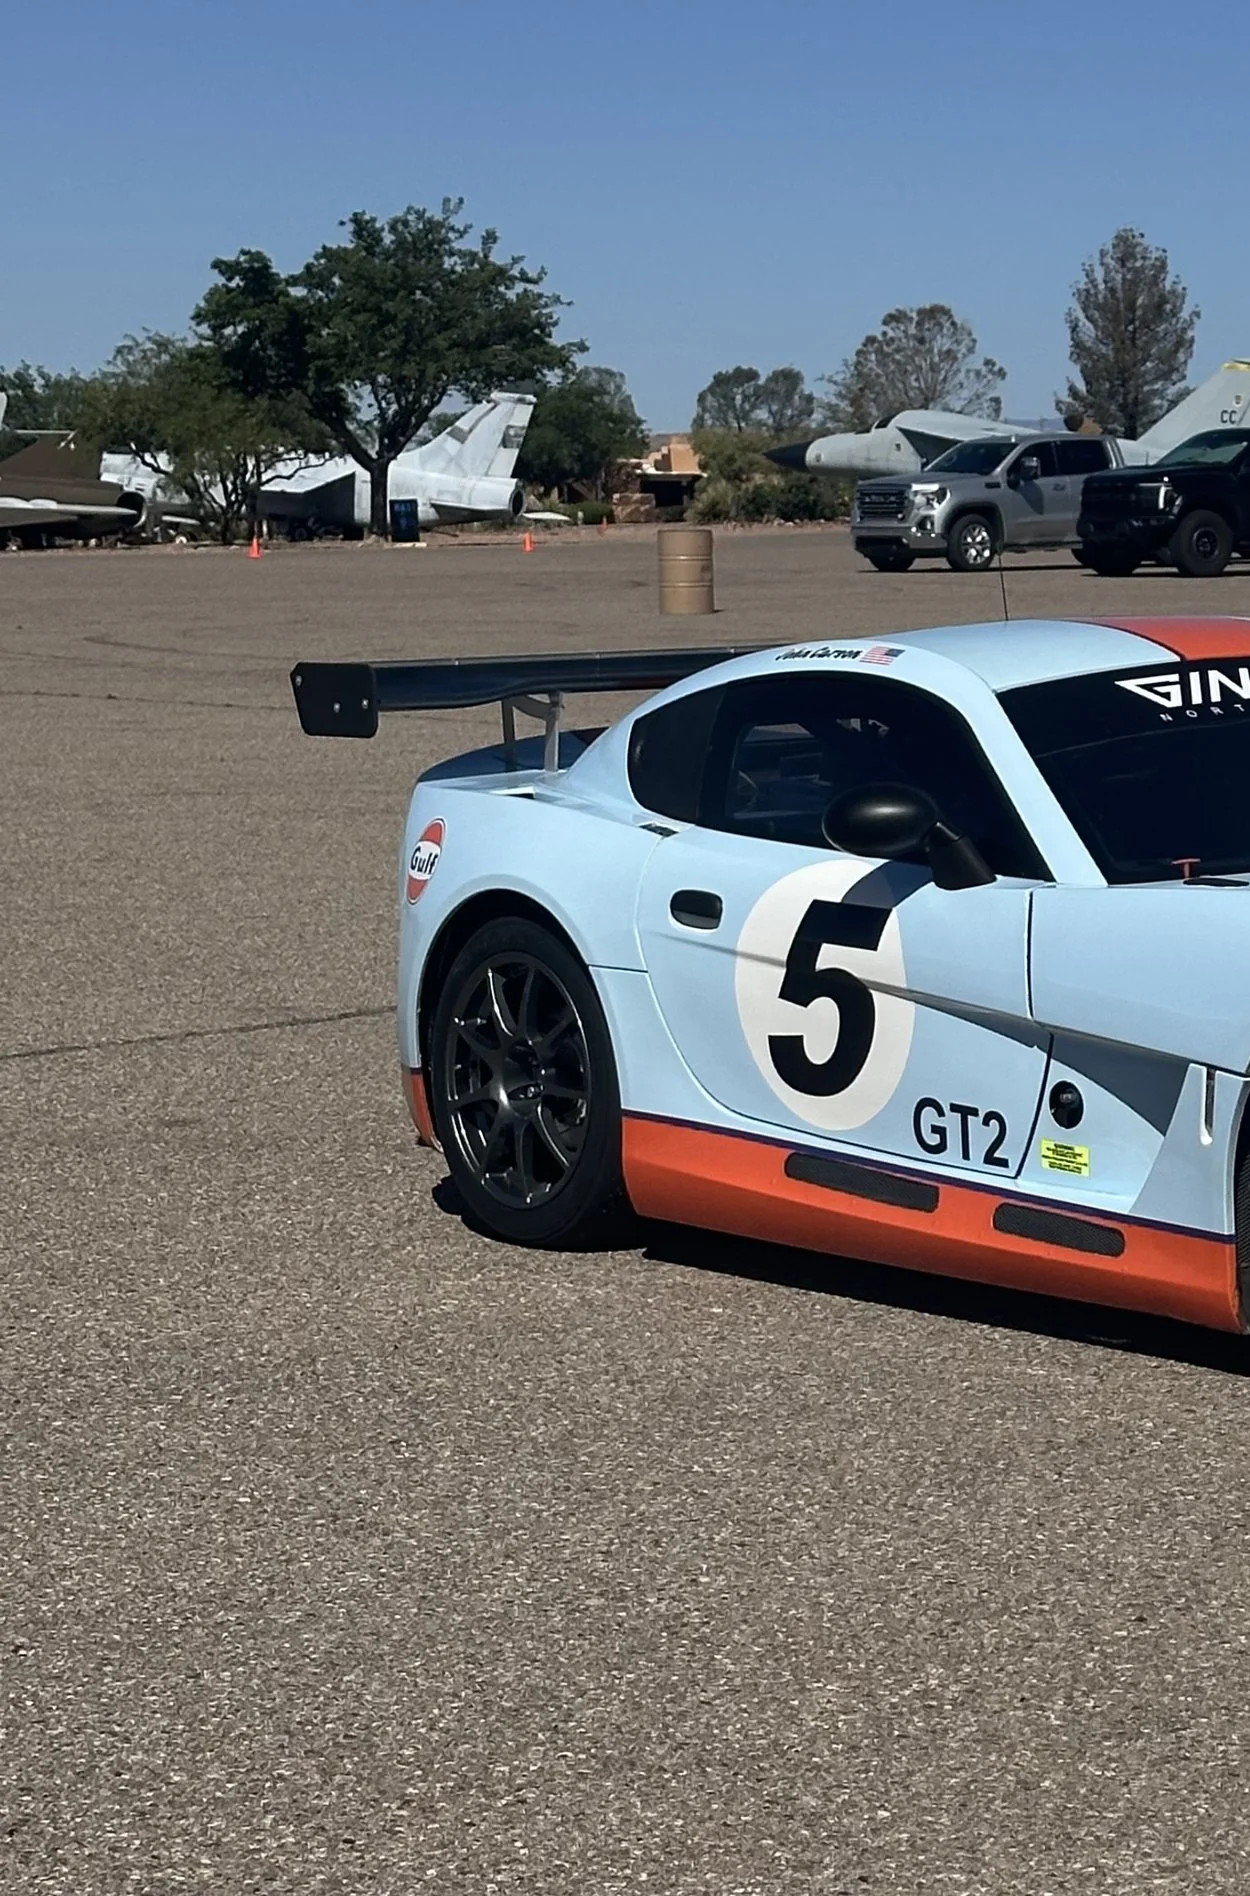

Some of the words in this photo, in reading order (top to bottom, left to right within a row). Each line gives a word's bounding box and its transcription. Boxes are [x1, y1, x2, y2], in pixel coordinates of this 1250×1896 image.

[1220, 409, 1238, 424] CC
[410, 845, 439, 875] Gulf
[768, 899, 893, 1097] 5
[913, 1097, 1010, 1169] GT2
